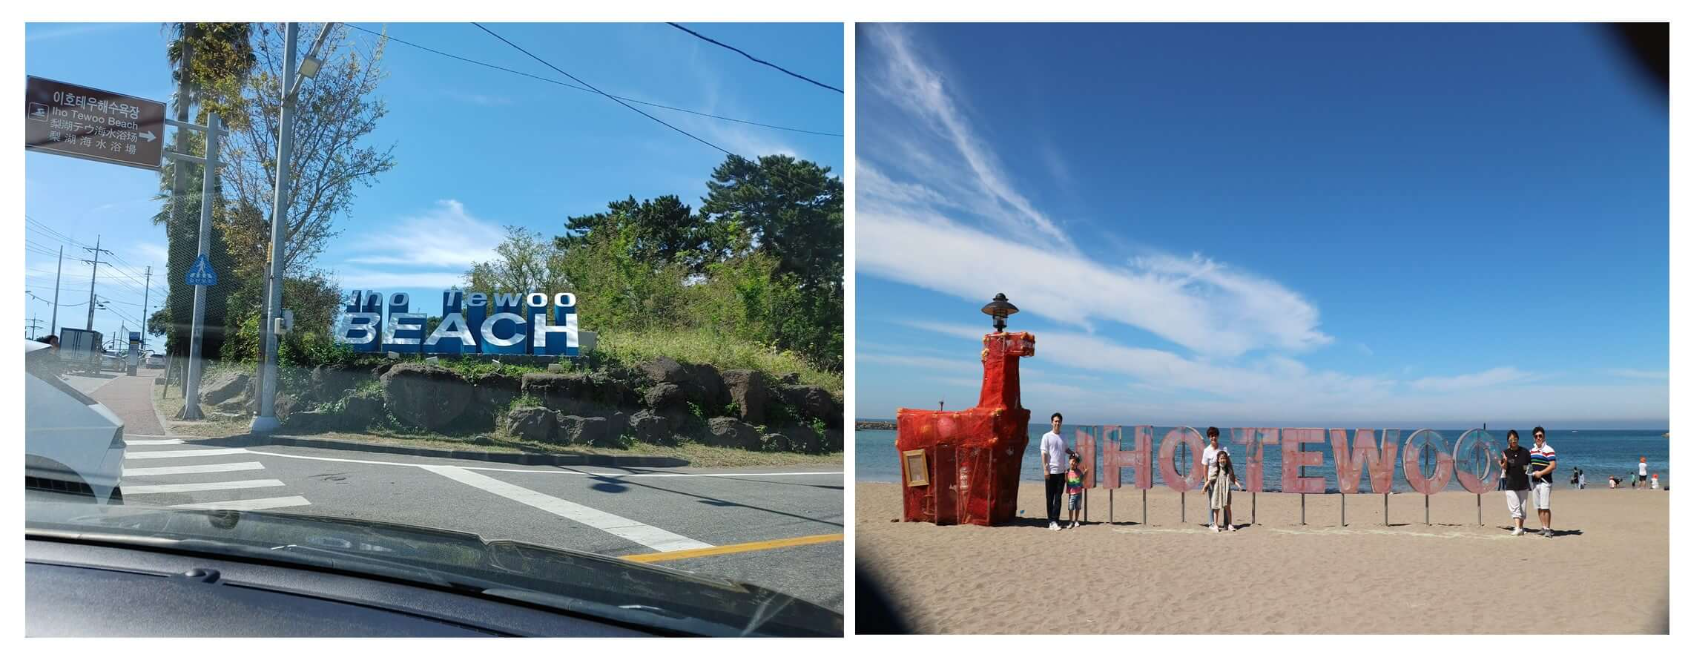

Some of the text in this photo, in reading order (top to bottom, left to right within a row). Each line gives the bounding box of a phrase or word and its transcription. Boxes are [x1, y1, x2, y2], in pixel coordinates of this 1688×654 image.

[52, 106, 138, 130] Iho Tewoo Beach
[53, 91, 140, 119] 이호테우해수욕장
[445, 288, 577, 308] Tewoo
[334, 312, 579, 348] BEACH
[1230, 427, 1499, 495] TEWOO
